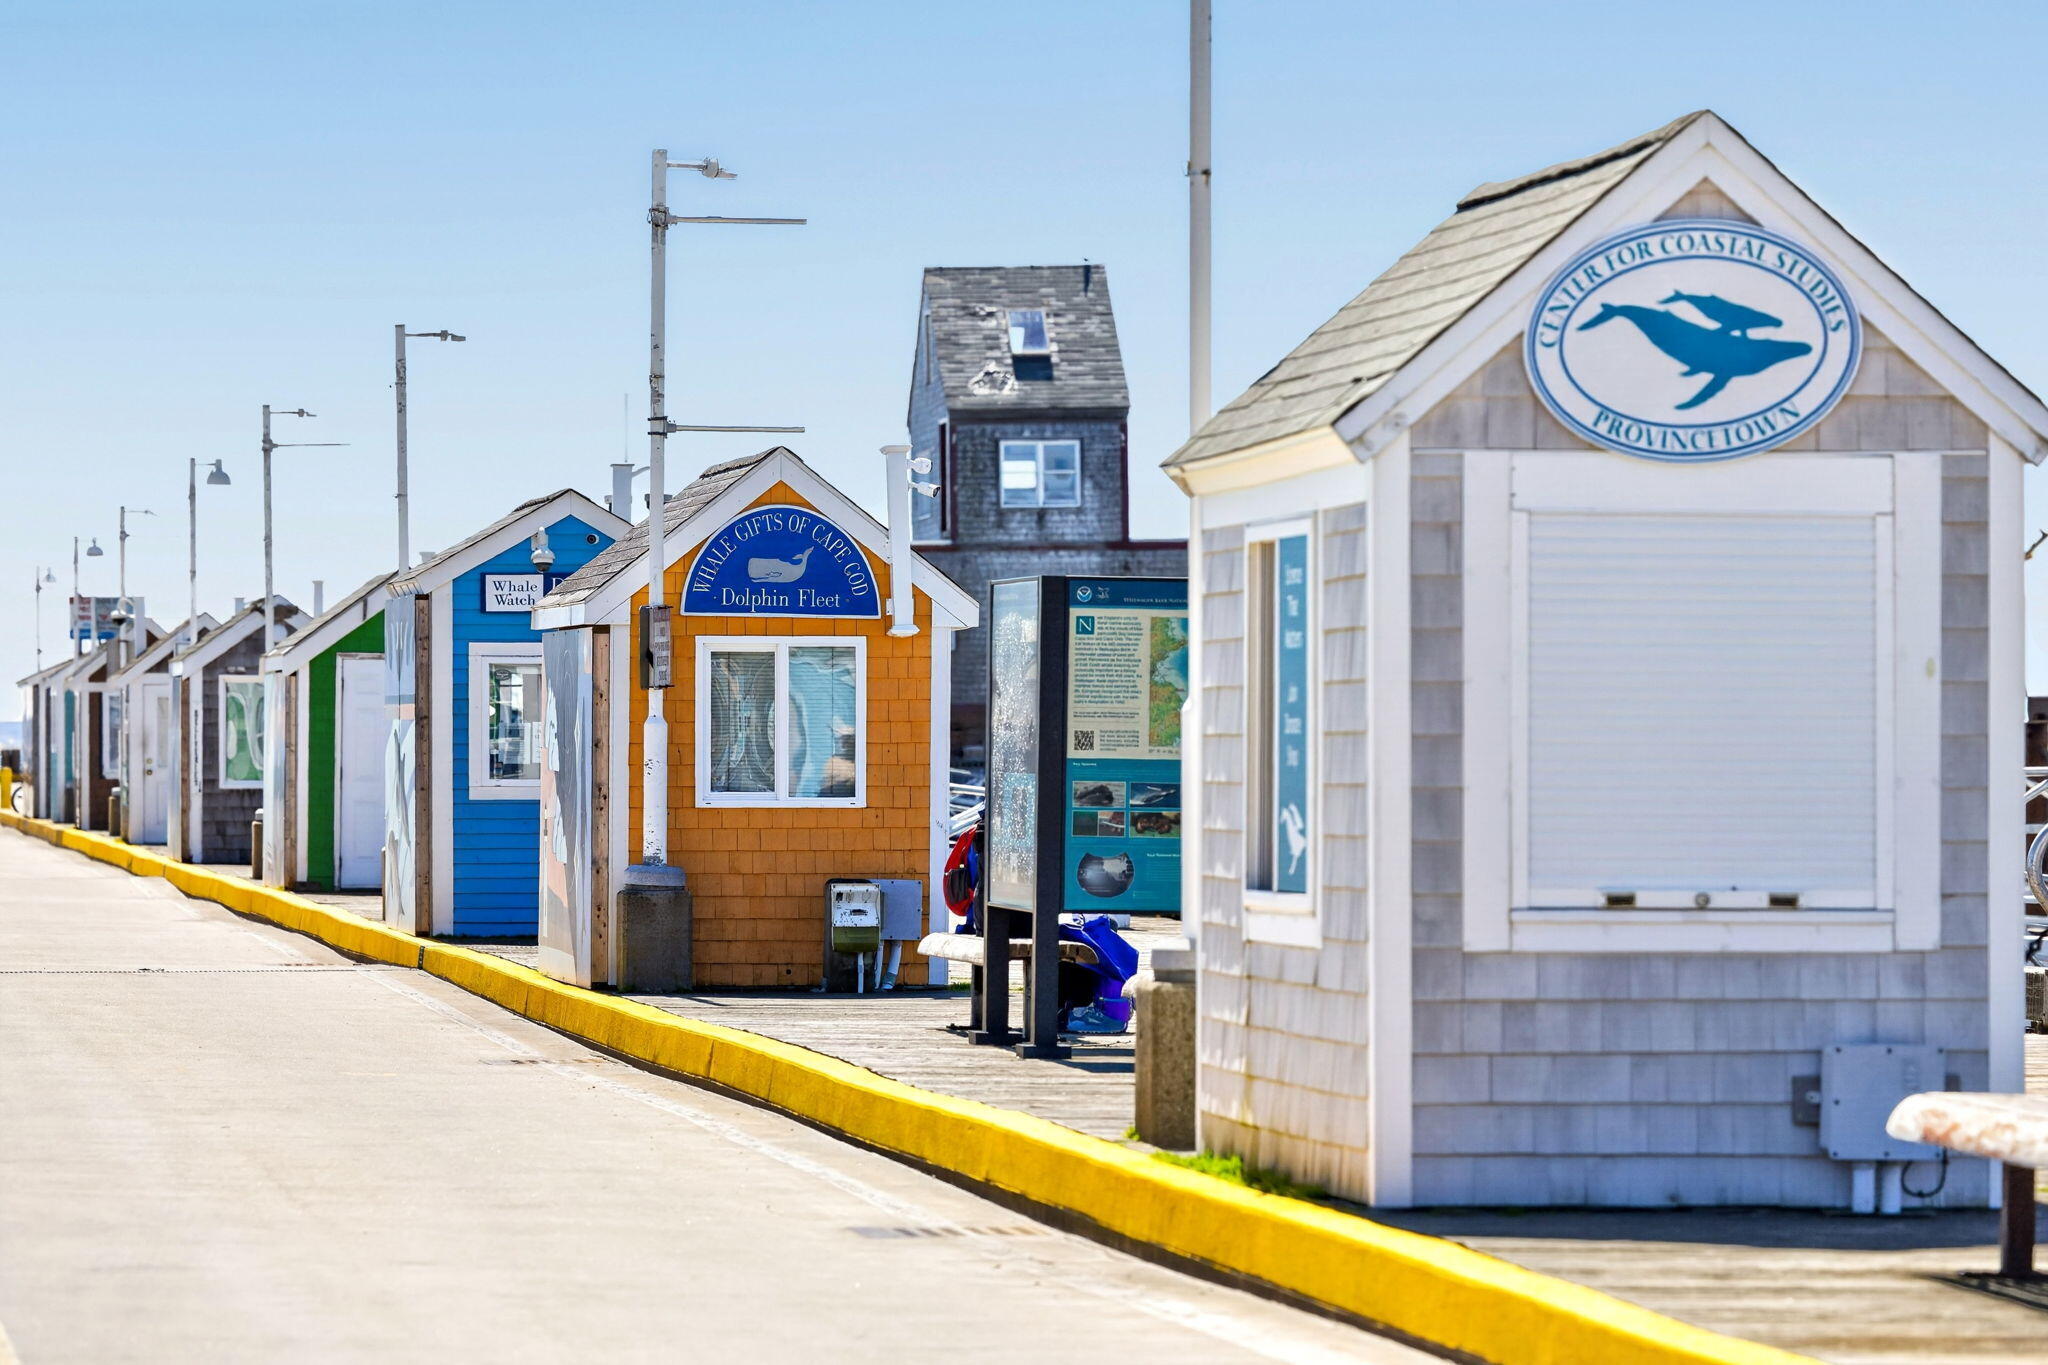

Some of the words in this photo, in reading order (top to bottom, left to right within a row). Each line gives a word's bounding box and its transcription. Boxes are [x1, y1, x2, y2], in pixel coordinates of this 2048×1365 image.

[1540, 264, 1602, 347] CENTER
[1604, 241, 1653, 271] FOR
[1660, 233, 1768, 262] COASTAL
[1773, 250, 1847, 333] STUDIES
[1592, 402, 1801, 450] PROVINCETOWN
[692, 535, 737, 592] WHALE
[734, 513, 783, 542] GIFTS
[788, 514, 811, 534] OF
[812, 524, 852, 563] CAPE
[843, 562, 869, 596] COD
[493, 580, 538, 592] Whale
[495, 594, 535, 606] Watch
[721, 587, 789, 612] Dolphin
[798, 588, 840, 608] Fleet
